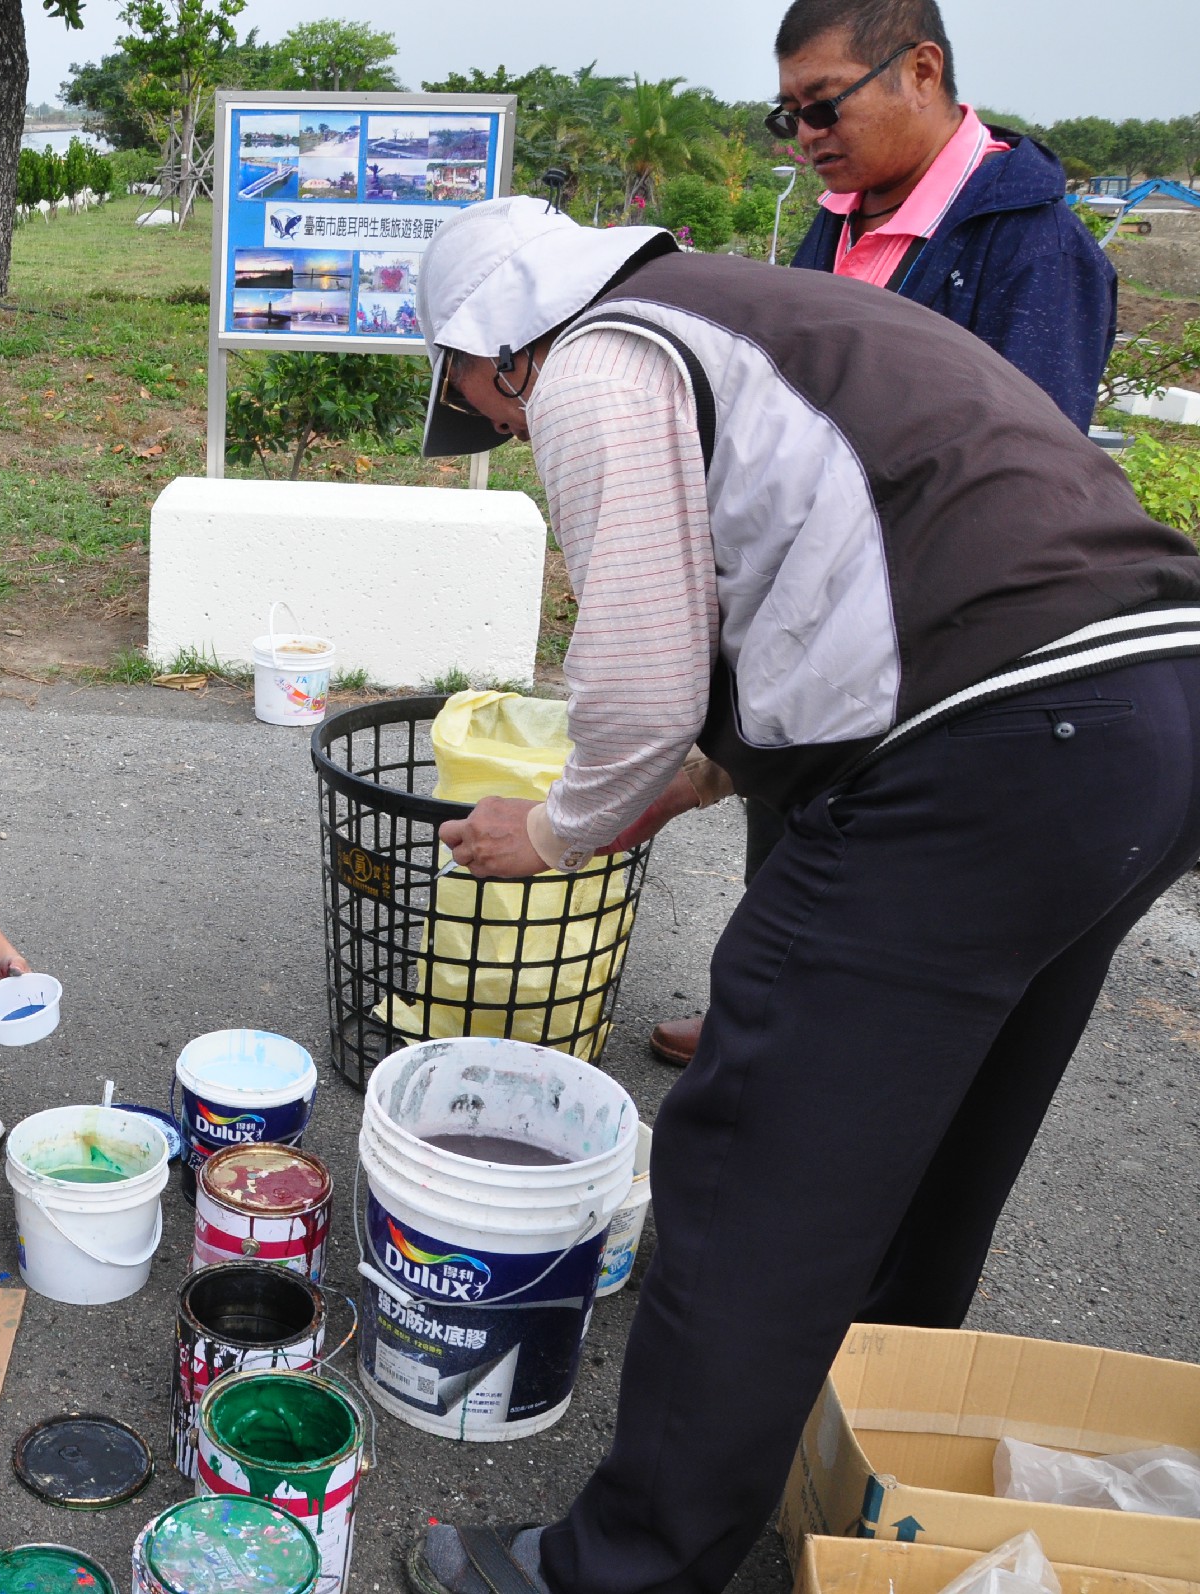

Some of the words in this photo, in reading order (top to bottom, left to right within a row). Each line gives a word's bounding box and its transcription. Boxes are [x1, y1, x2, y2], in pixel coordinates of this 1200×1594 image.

[195, 1114, 256, 1142] Dulux
[384, 1241, 472, 1301] Dulux
[442, 1264, 475, 1283] 得利
[377, 1289, 488, 1350] 強力防水底膠
